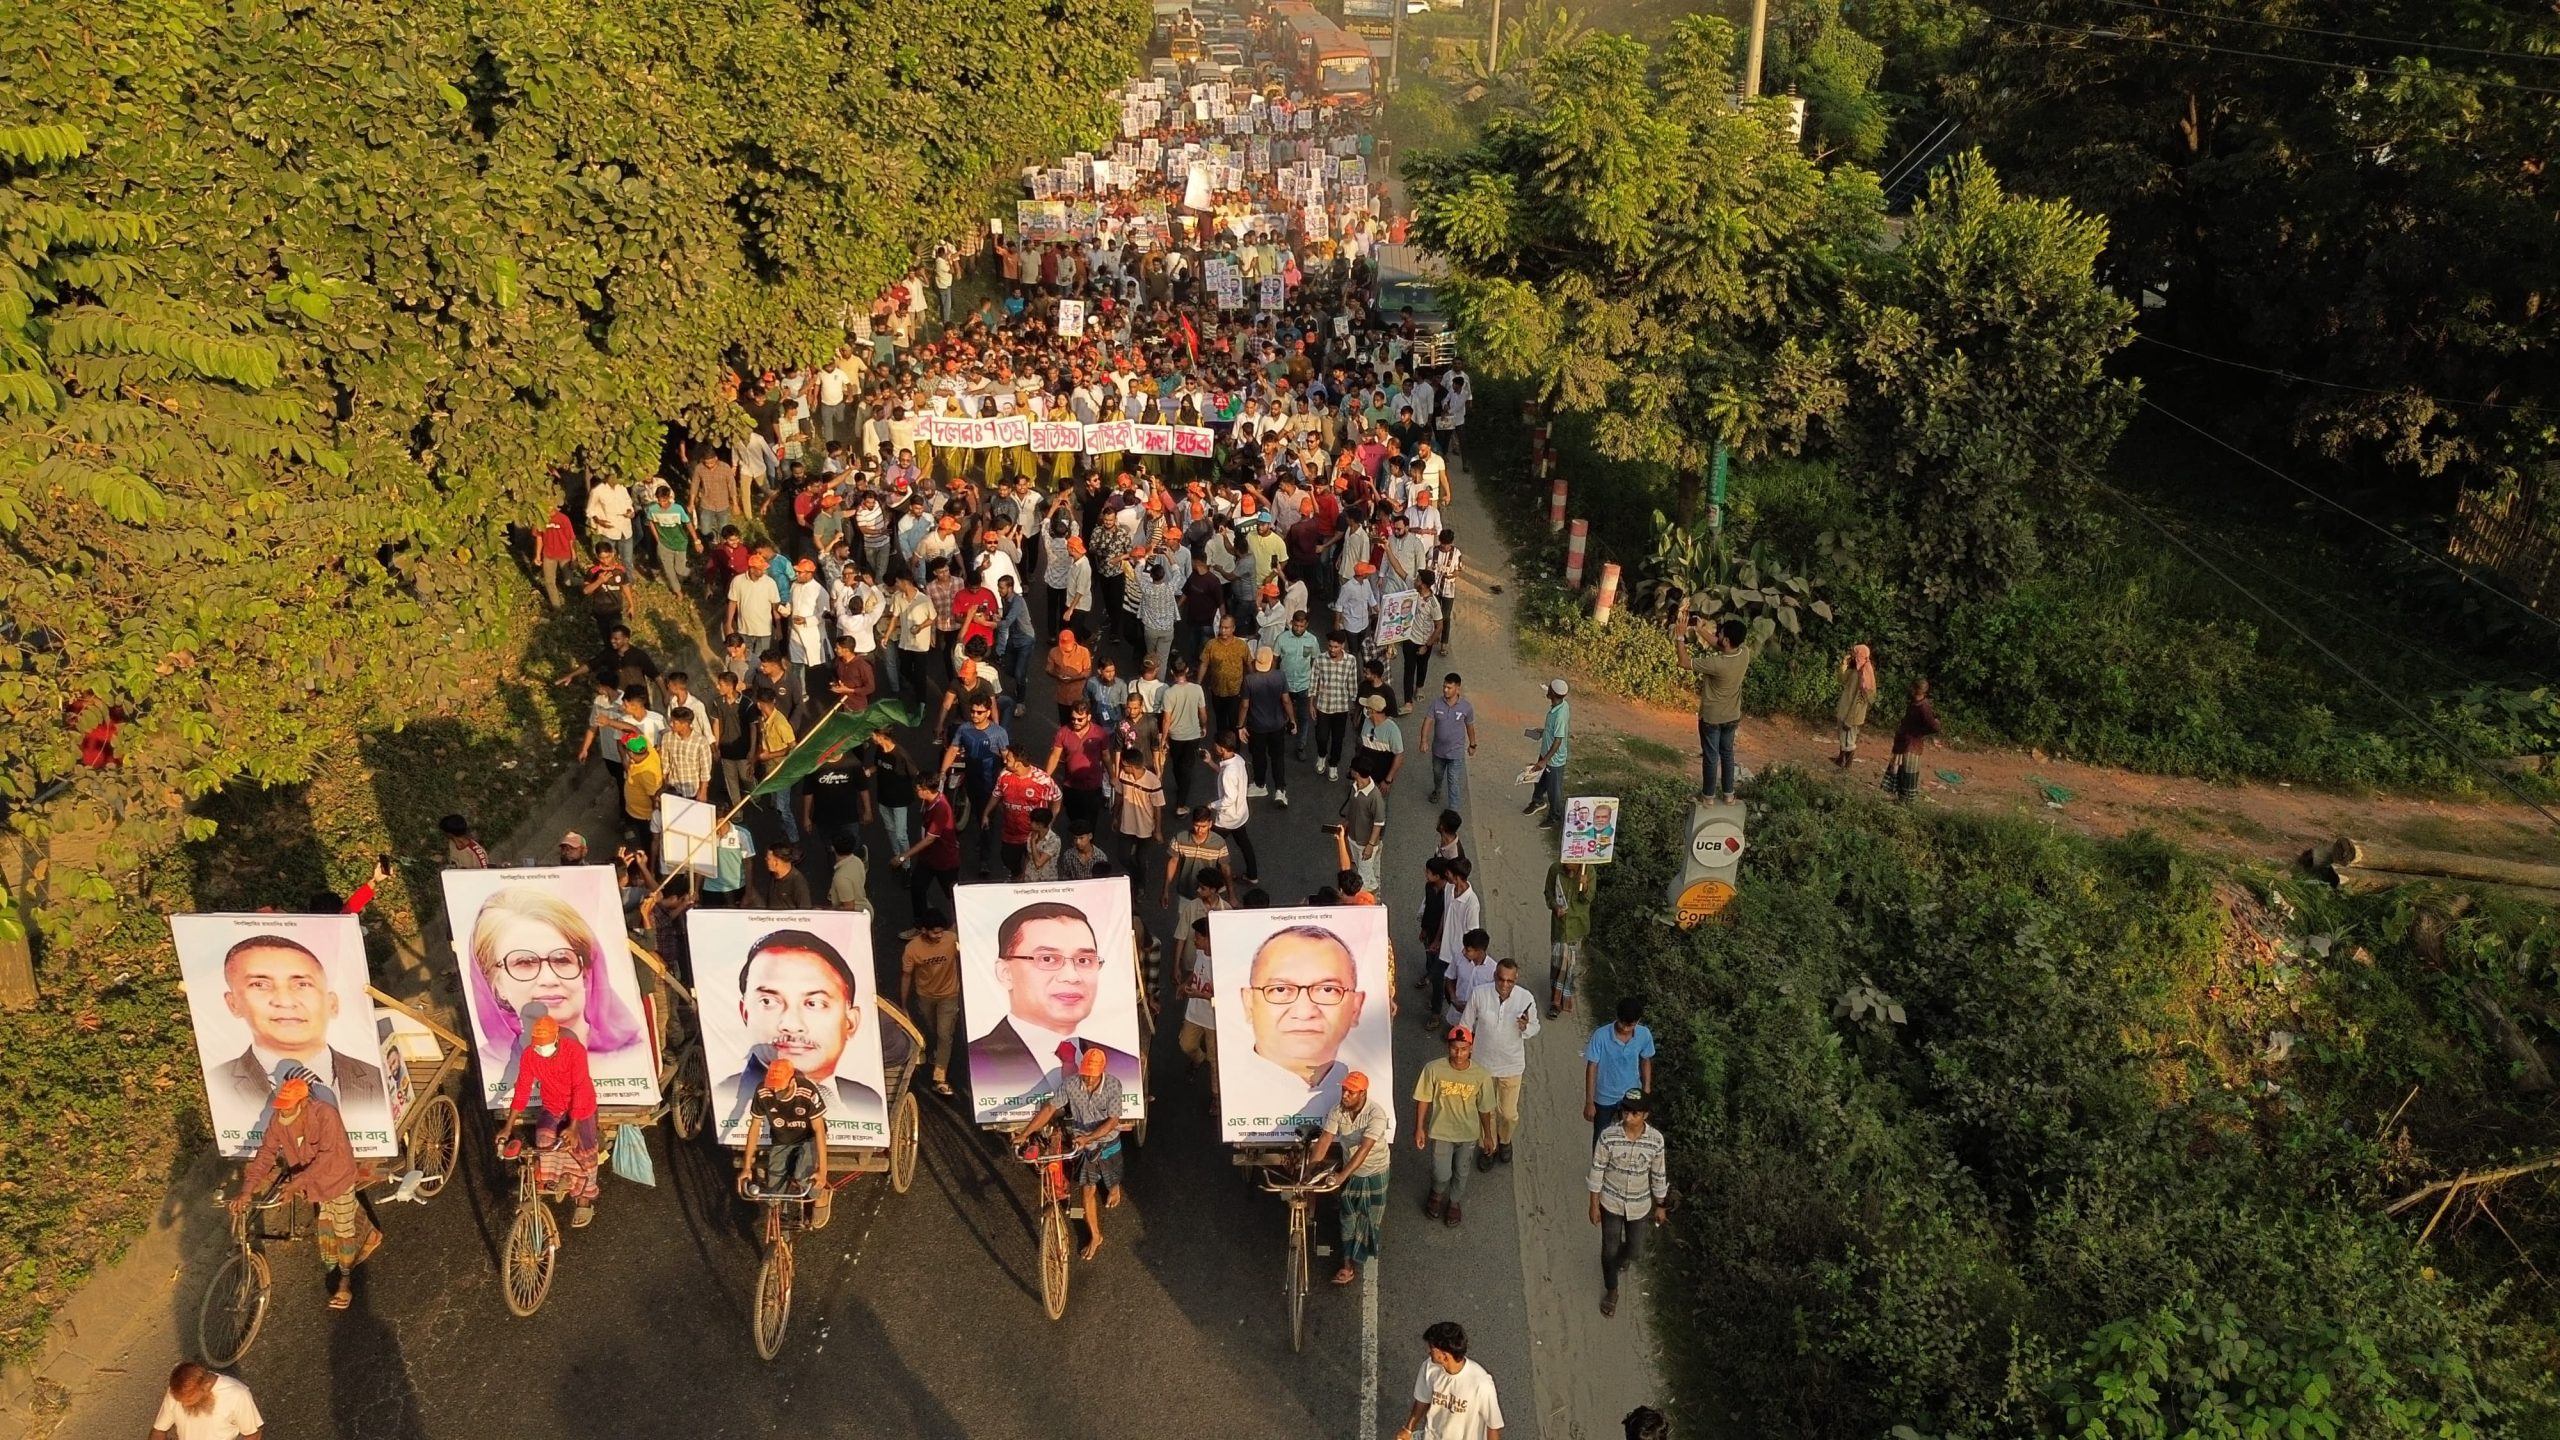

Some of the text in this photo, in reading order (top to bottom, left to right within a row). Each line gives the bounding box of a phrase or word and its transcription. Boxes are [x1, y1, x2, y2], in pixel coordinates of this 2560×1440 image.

[1696, 841, 1722, 851] UCB
[593, 1078, 625, 1087] সলাম
[626, 1077, 651, 1090] বাবু
[825, 1119, 860, 1131] সলাম
[861, 1121, 885, 1135] বাবু
[364, 1130, 390, 1143] বাবু
